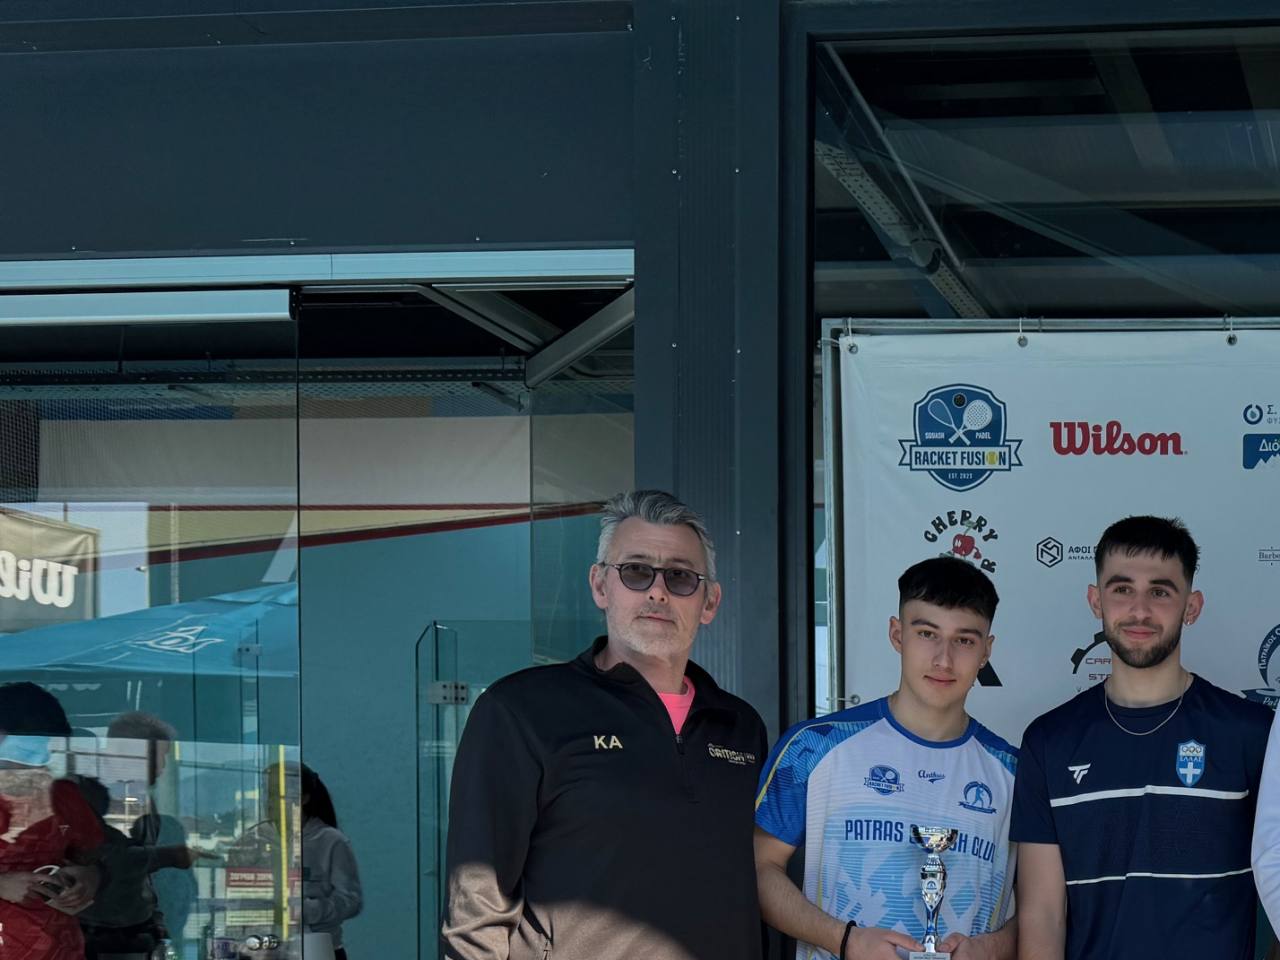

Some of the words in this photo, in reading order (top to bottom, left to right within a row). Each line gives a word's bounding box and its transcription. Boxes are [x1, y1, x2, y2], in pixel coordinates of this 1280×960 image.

[1049, 420, 1184, 455] Wilson
[914, 450, 958, 466] RACKET
[845, 819, 904, 843] PATRAS
